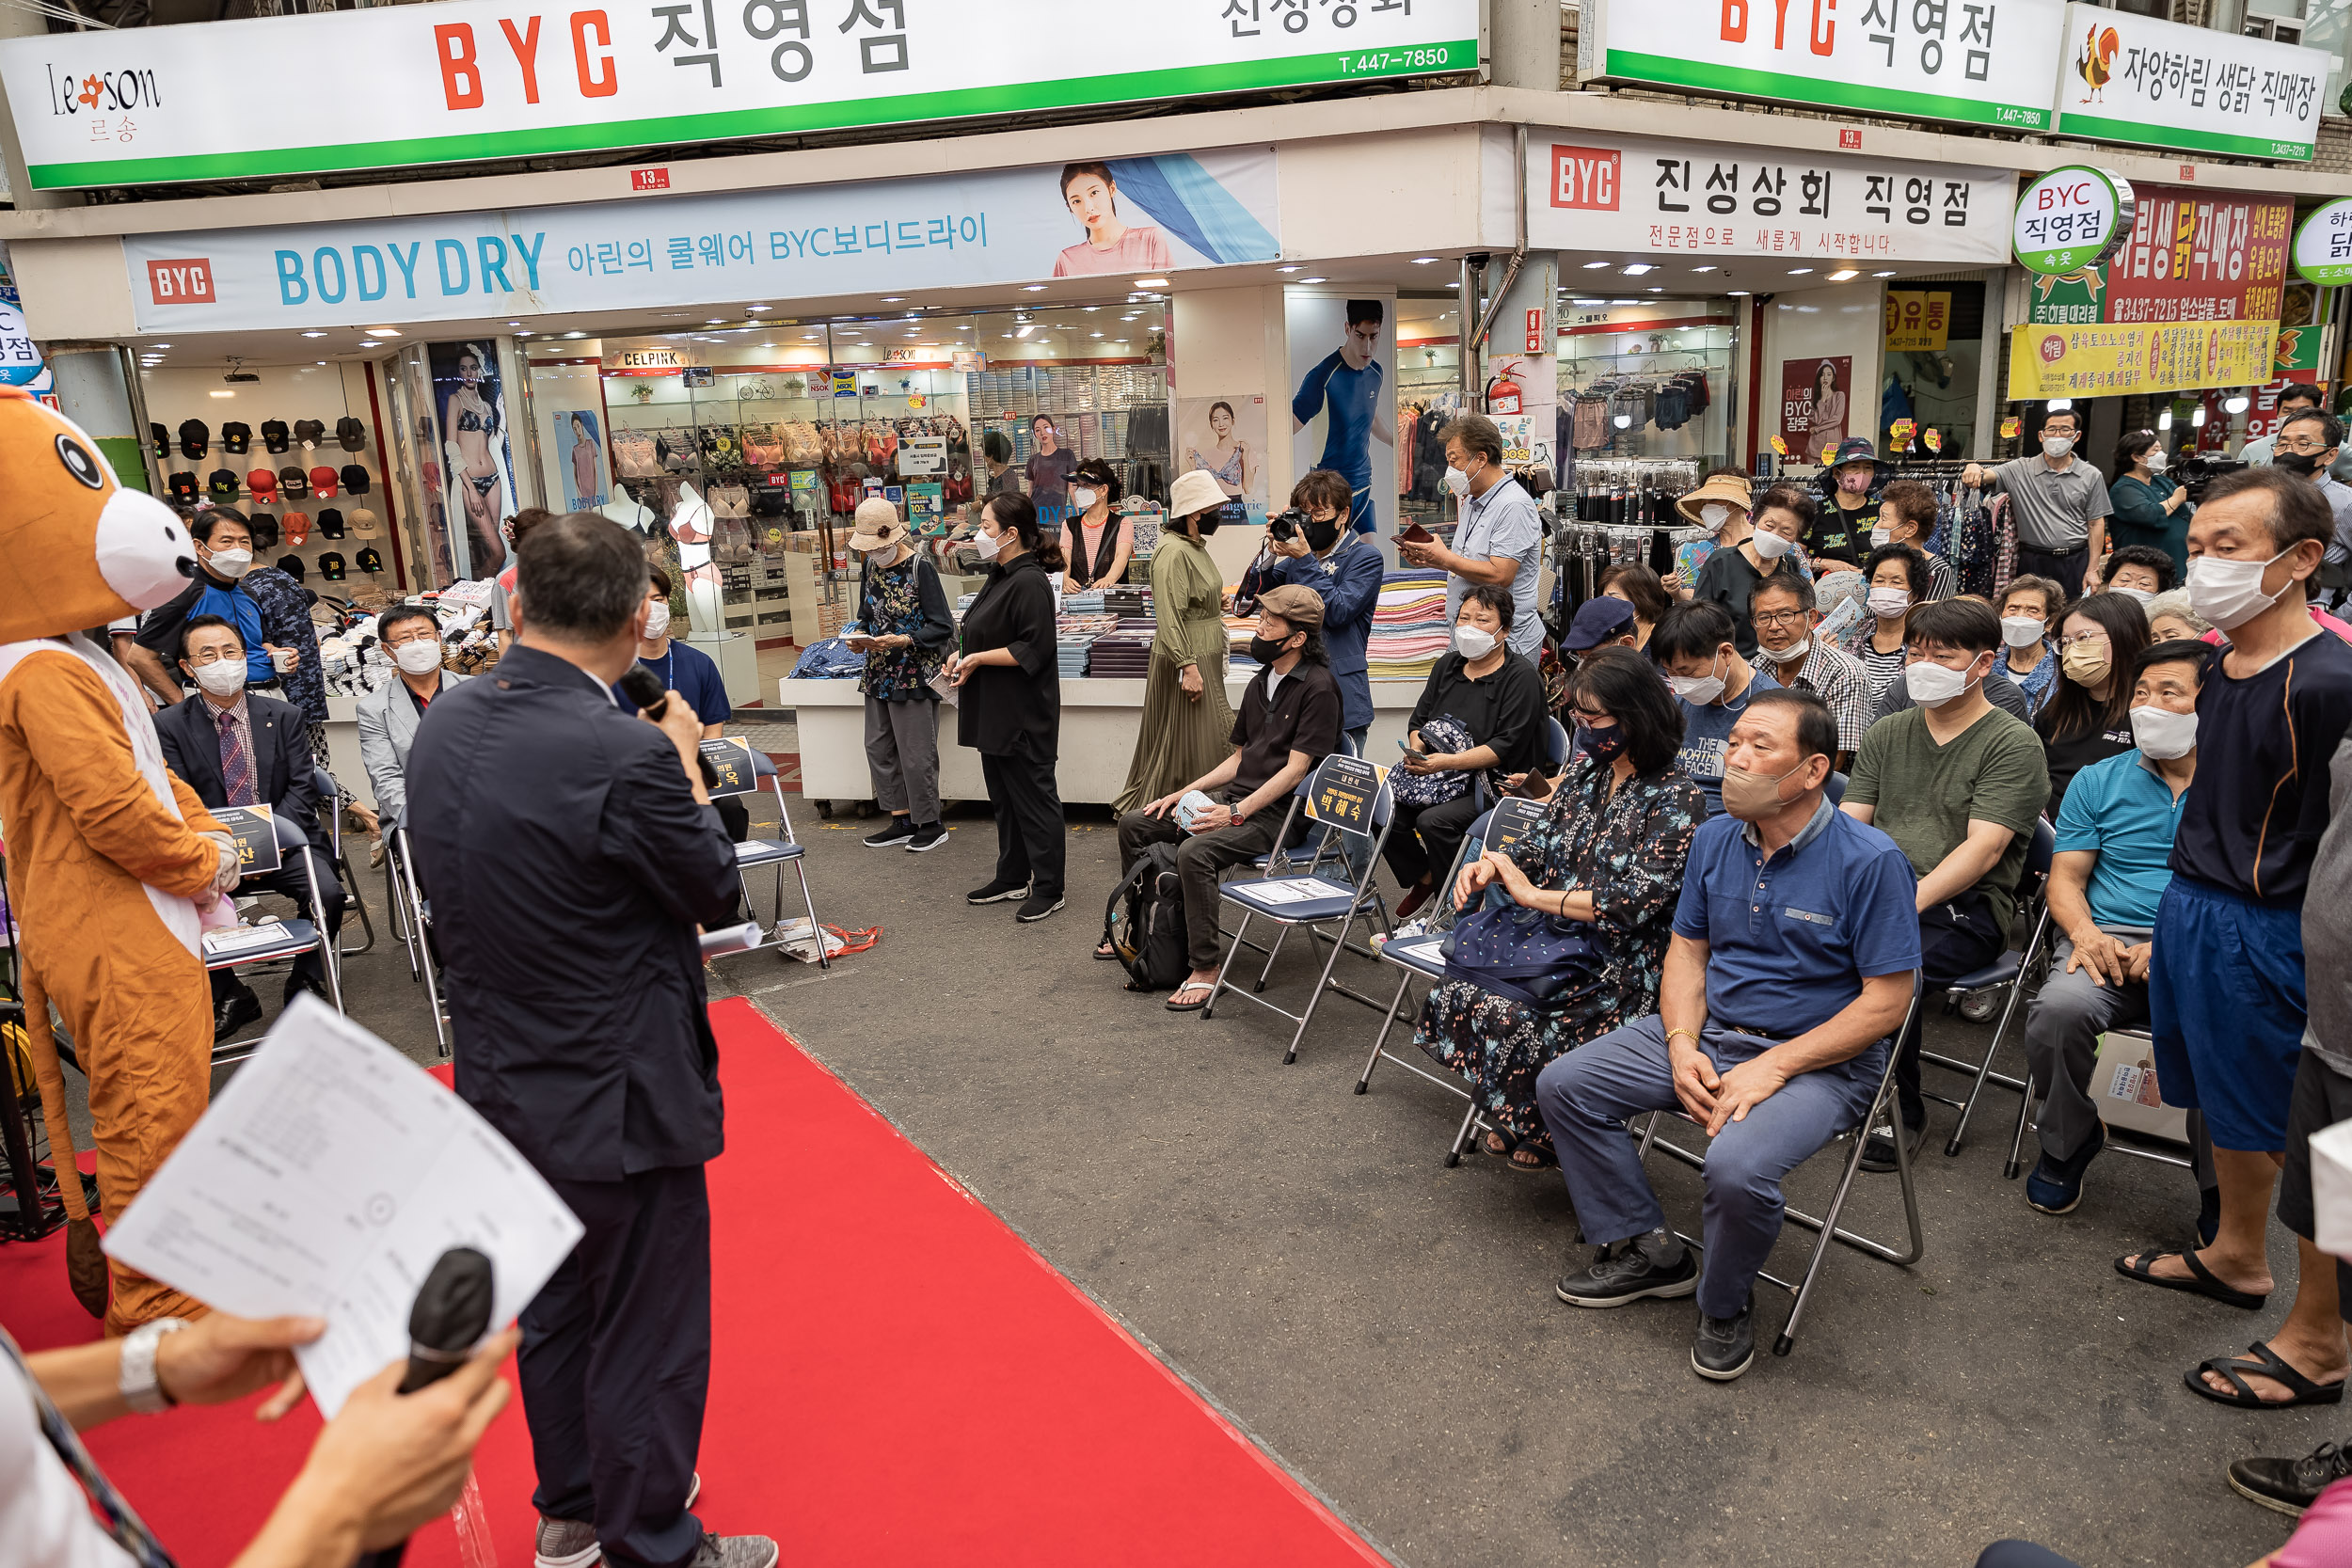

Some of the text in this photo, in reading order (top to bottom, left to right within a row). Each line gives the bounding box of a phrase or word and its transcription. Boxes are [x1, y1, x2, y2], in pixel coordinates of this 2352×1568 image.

[434, 8, 619, 111] BYC
[1338, 48, 1449, 73] T.447-7850
[2123, 47, 2316, 121] 자양하림 생닭 직매장
[1995, 107, 2042, 126] T.447-7850
[89, 115, 137, 143] 르송
[1845, 131, 1854, 144] 13
[640, 170, 656, 184] 13
[1558, 156, 1970, 227] BYC 진성상회 직영점
[2038, 182, 2091, 211] BYC
[2025, 210, 2101, 244] 직영점
[1649, 225, 1897, 255] 전문점으로 새롭게 시작합니다.
[274, 213, 987, 306] BODY DRY 아린의 쿨웨어 BYC보디드라이
[2043, 251, 2073, 267] 속옷
[155, 266, 207, 297] BYC
[2123, 297, 2178, 322] 3437-7215
[2043, 340, 2062, 358] 하림
[625, 352, 677, 366] CELPINK
[1786, 386, 1812, 401] 아린의
[1785, 401, 1812, 417] BYC
[1499, 421, 1527, 436] SALE
[1787, 417, 1808, 432] 잠옷
[771, 476, 785, 484] BYC
[368, 554, 378, 564] A
[1698, 737, 1718, 751] THE
[1677, 748, 1715, 764] NORTH
[717, 763, 733, 771] 의원
[1685, 761, 1710, 775] FACE
